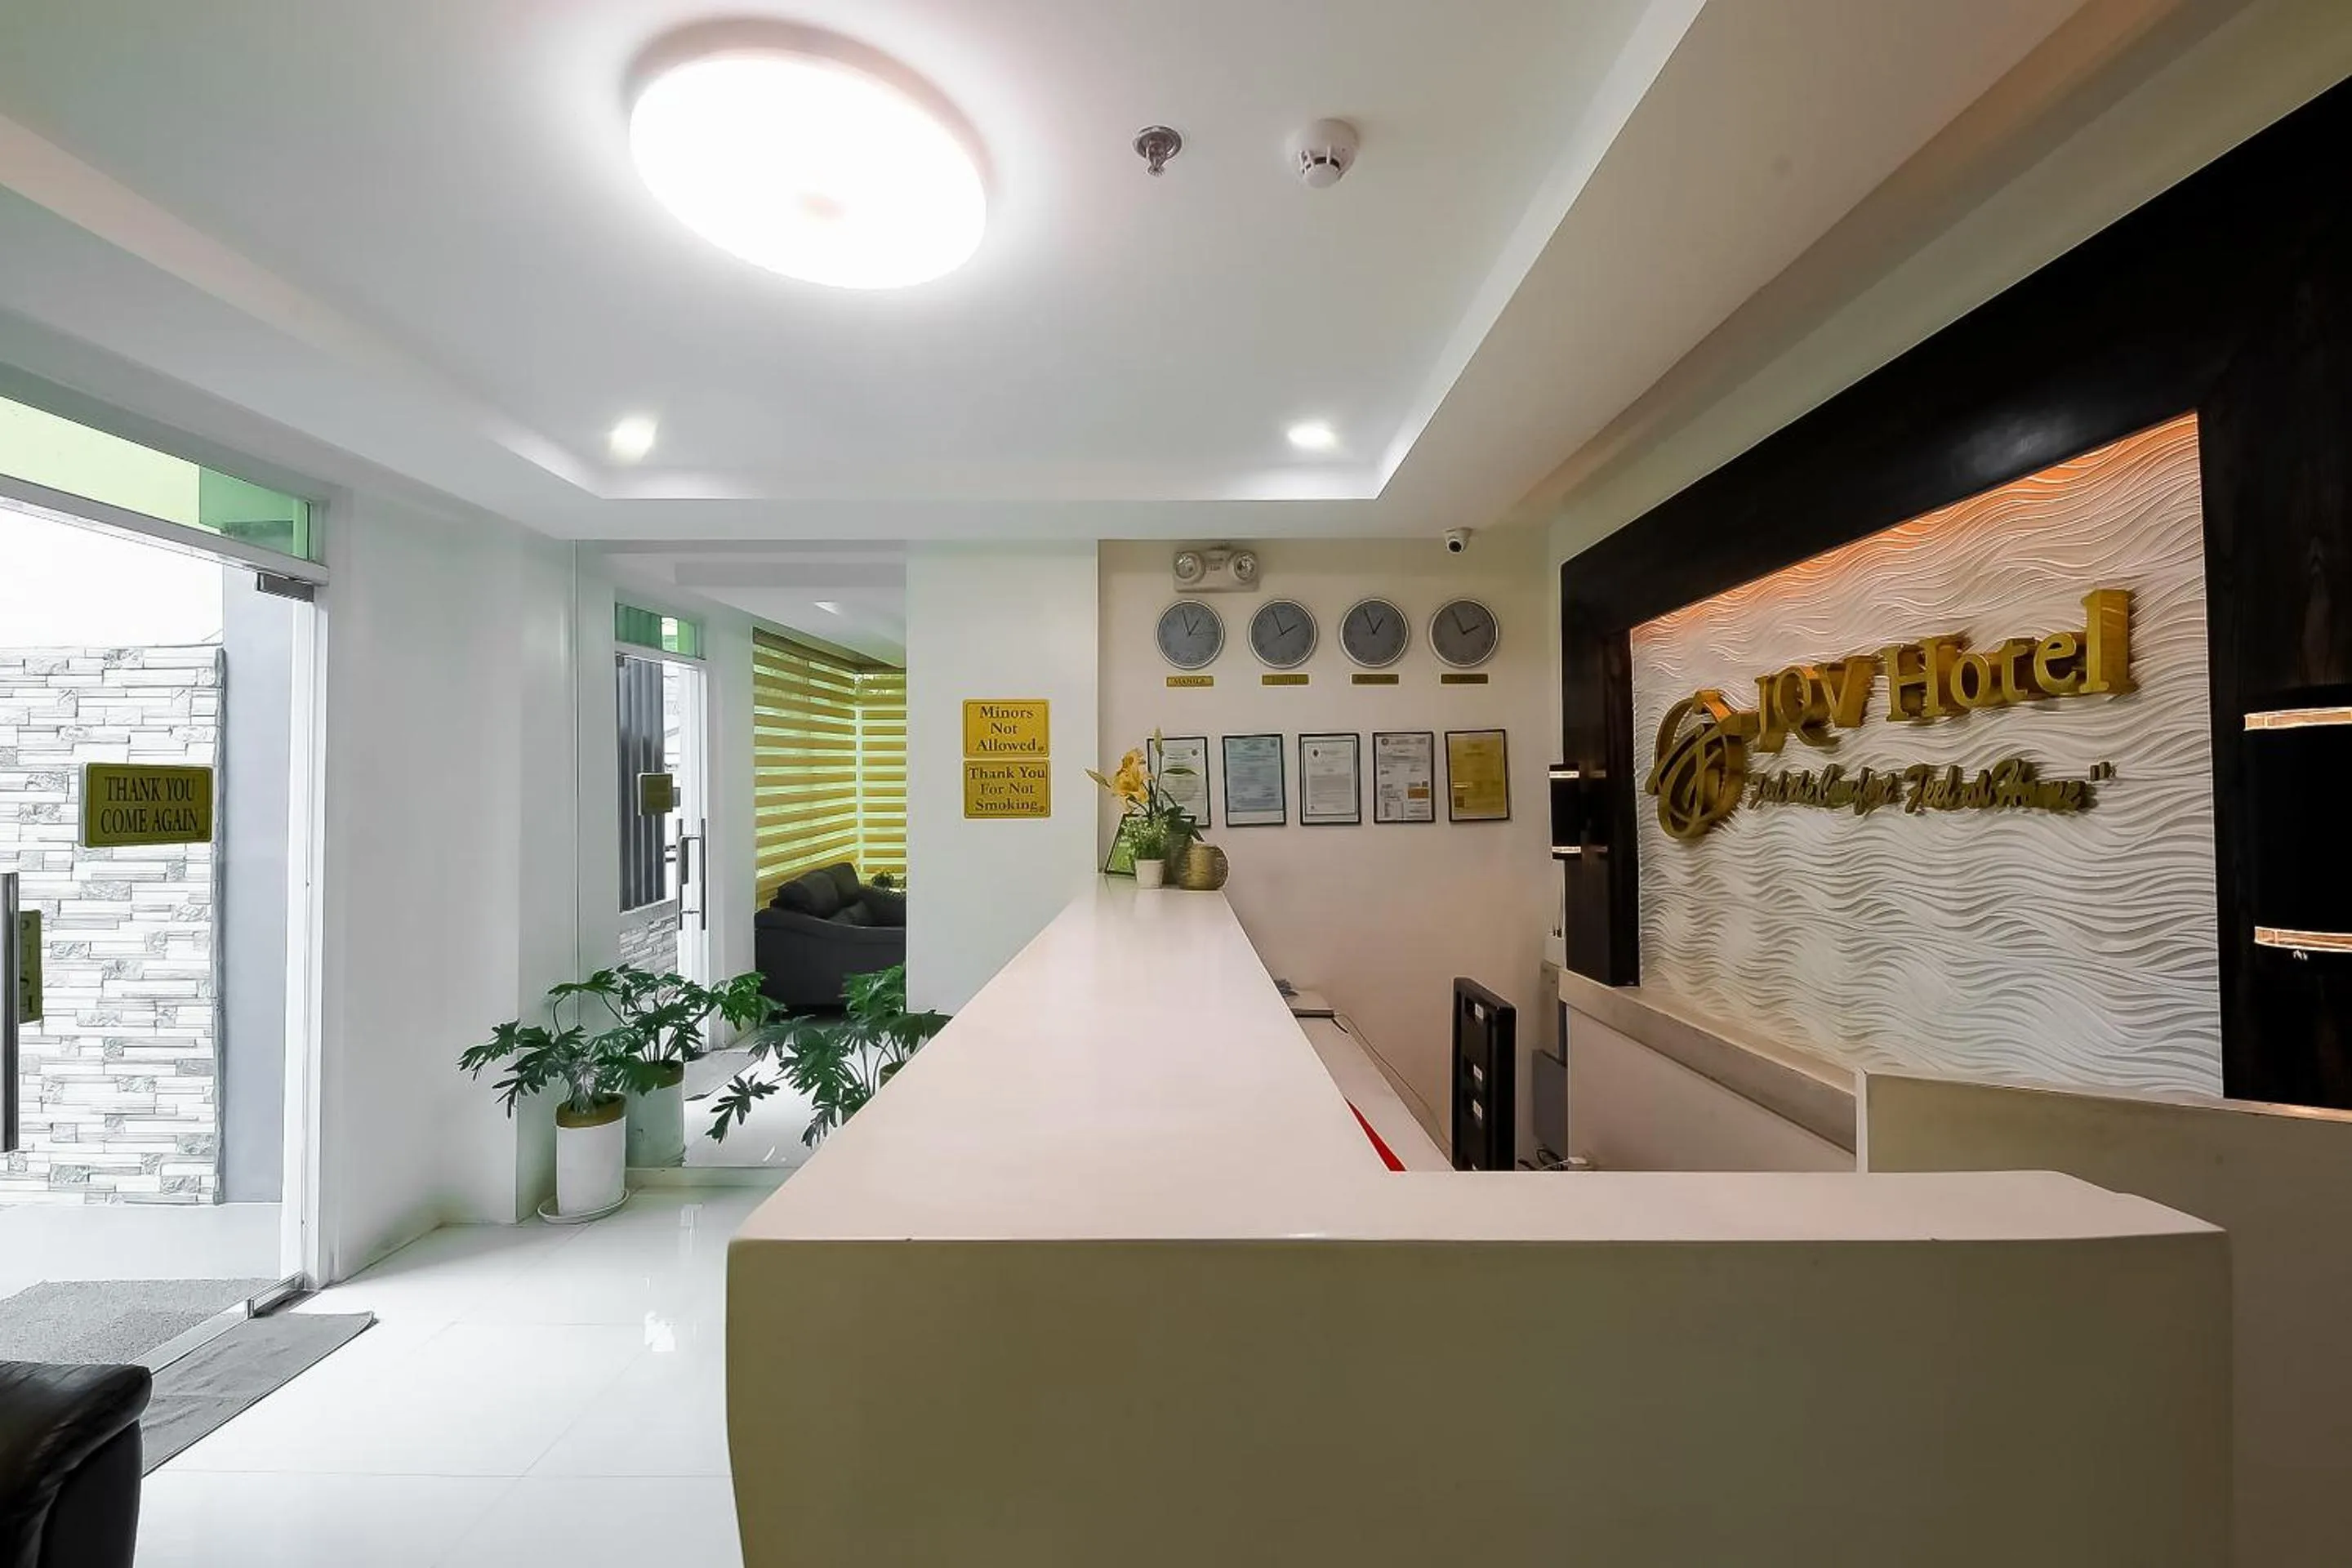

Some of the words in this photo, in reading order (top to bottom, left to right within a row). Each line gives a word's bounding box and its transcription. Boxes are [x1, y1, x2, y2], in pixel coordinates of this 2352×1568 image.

[1882, 589, 2133, 721] Hotel
[980, 706, 1034, 719] Minors
[991, 722, 1018, 734] Not
[977, 737, 1036, 751] Allowed
[969, 766, 1014, 778] Thank
[1019, 766, 1045, 778] You
[105, 776, 161, 801] THANK
[166, 777, 195, 801] YOU
[981, 783, 1004, 795] For
[1009, 782, 1035, 794] Not
[975, 798, 1037, 812] Smoking
[100, 808, 147, 834] COME
[152, 807, 198, 832] AGAIN
